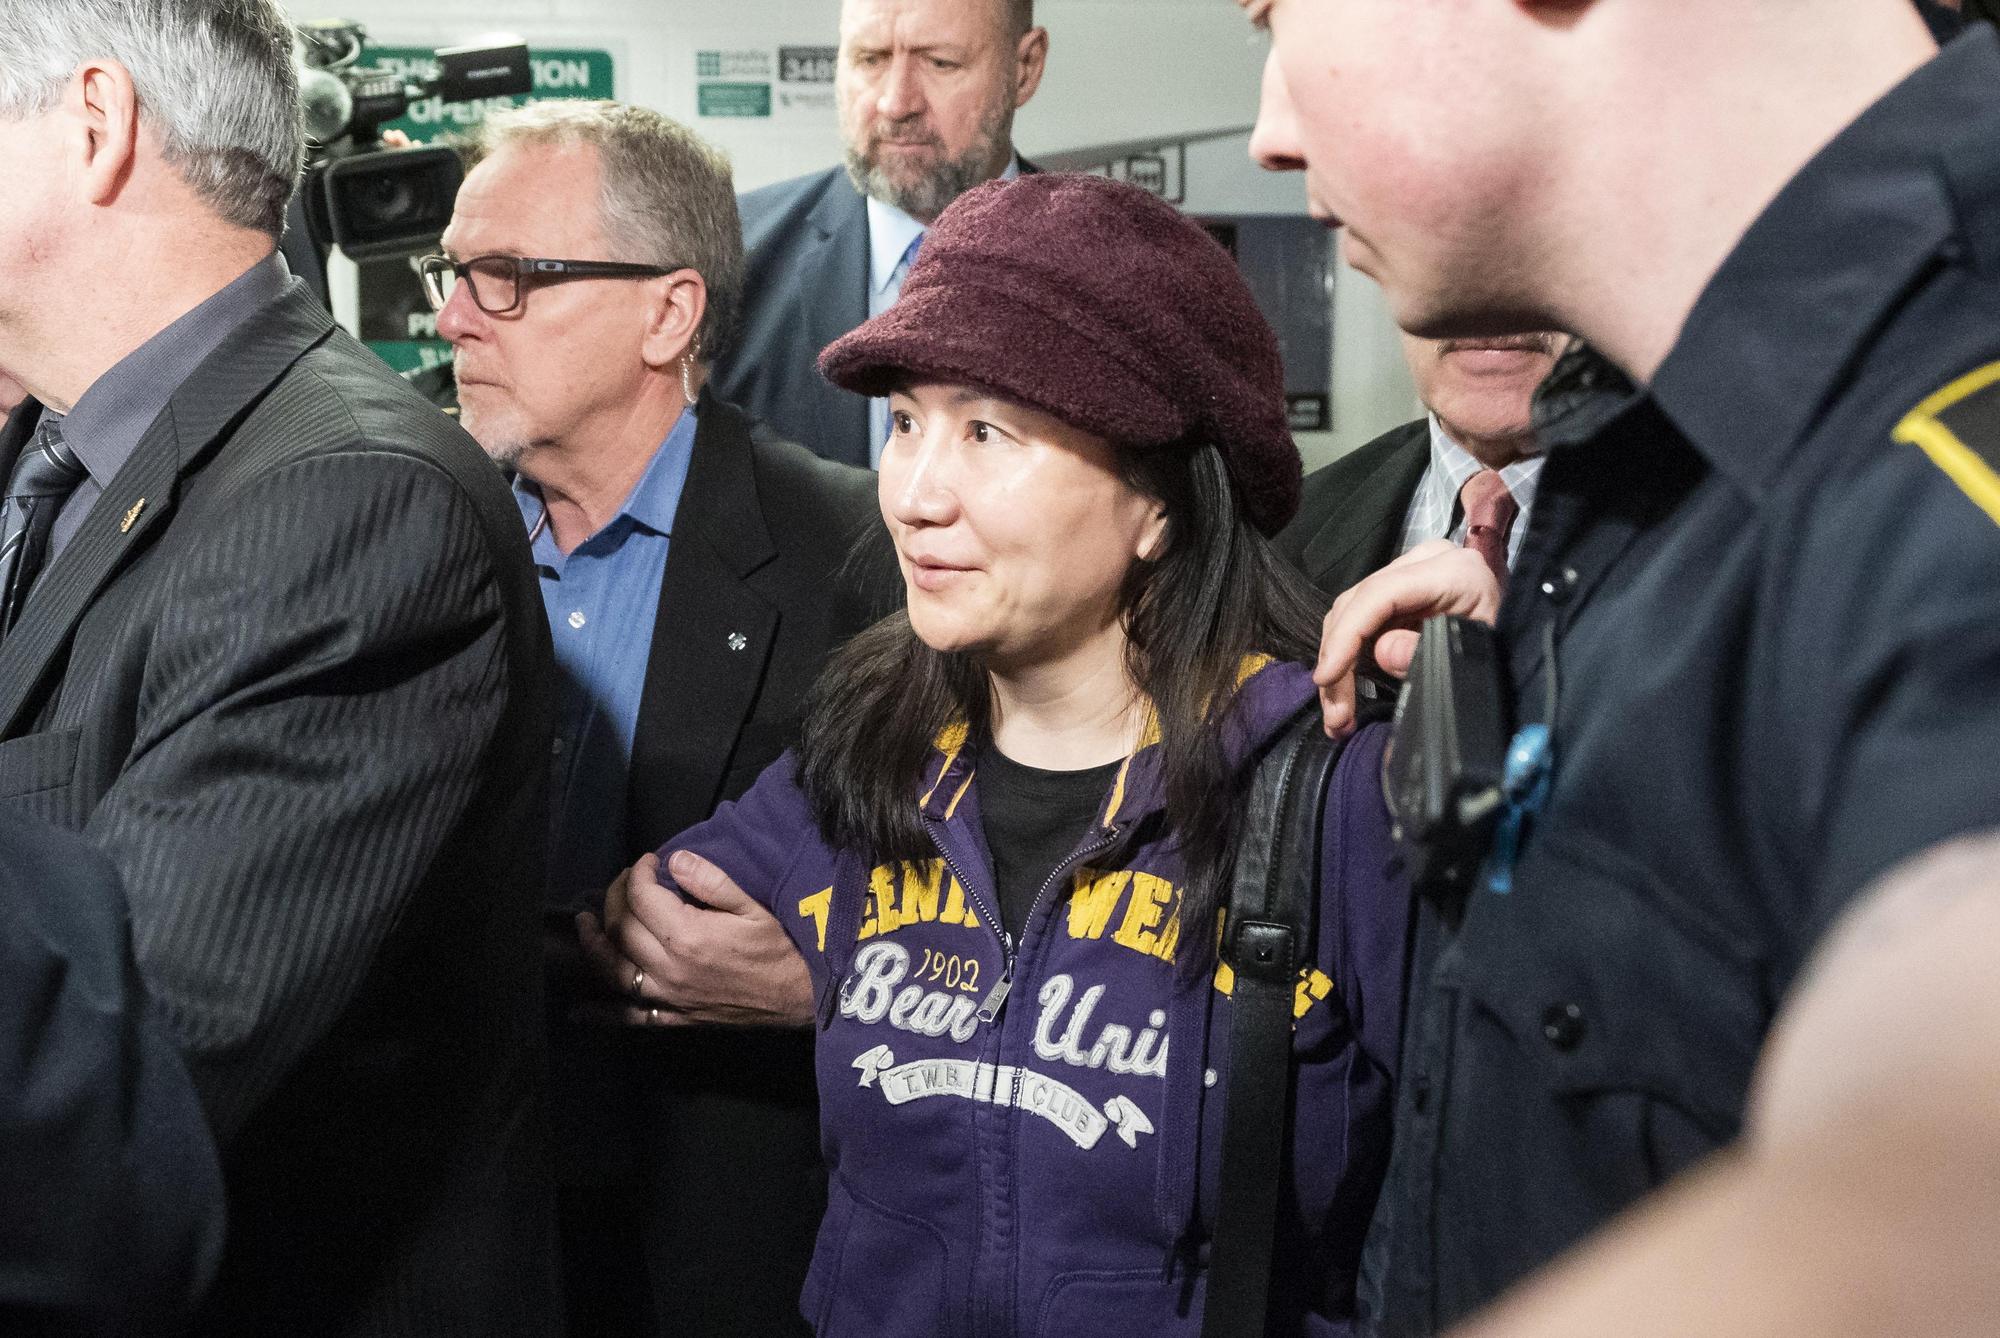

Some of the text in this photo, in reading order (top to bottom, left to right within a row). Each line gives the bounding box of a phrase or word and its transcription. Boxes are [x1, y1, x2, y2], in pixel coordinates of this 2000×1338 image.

[840, 940, 980, 1044] Bear
[914, 948, 980, 993] 1902
[1033, 1081, 1090, 1134] CLUB
